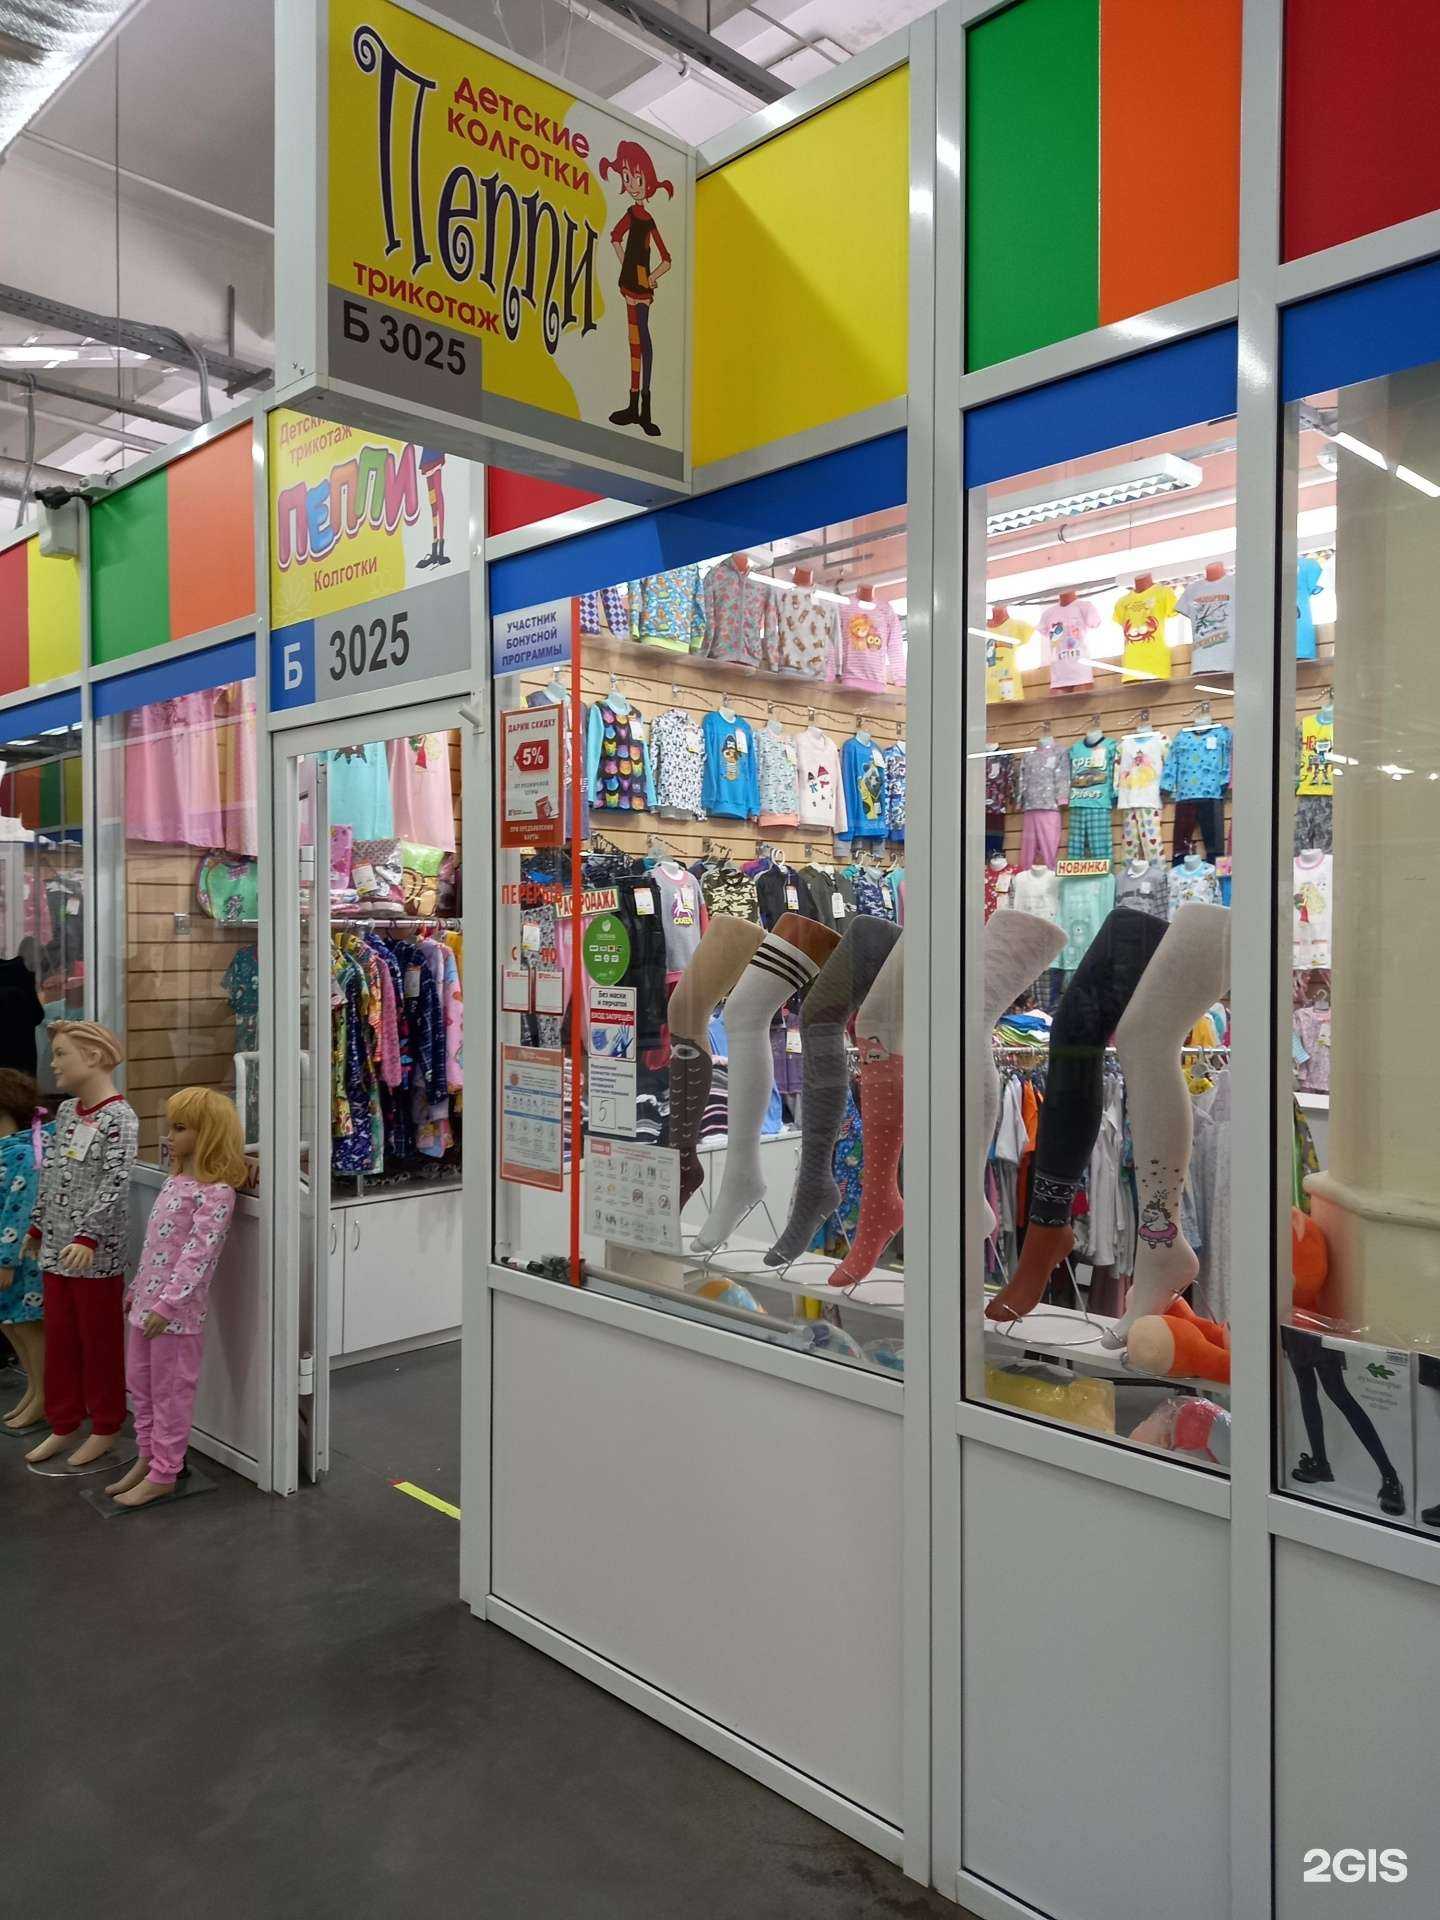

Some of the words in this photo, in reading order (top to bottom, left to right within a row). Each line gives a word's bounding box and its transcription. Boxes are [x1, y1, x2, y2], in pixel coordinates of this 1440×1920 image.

[454, 77, 590, 159] детские
[447, 108, 590, 195] колготки
[353, 25, 598, 355] Пеппи
[352, 260, 500, 336] трикотаж
[343, 300, 371, 345] Б
[379, 314, 467, 376] 3025
[314, 556, 378, 592] Колготки
[506, 611, 557, 633] УЧАСТНИК
[506, 627, 558, 650] БОНУСНОЙ
[283, 642, 303, 691] Б
[329, 611, 410, 681] 3025
[502, 644, 562, 666] ПРОГРАММЫ
[522, 746, 544, 765] 5%
[1058, 860, 1108, 875] НОВИНКА
